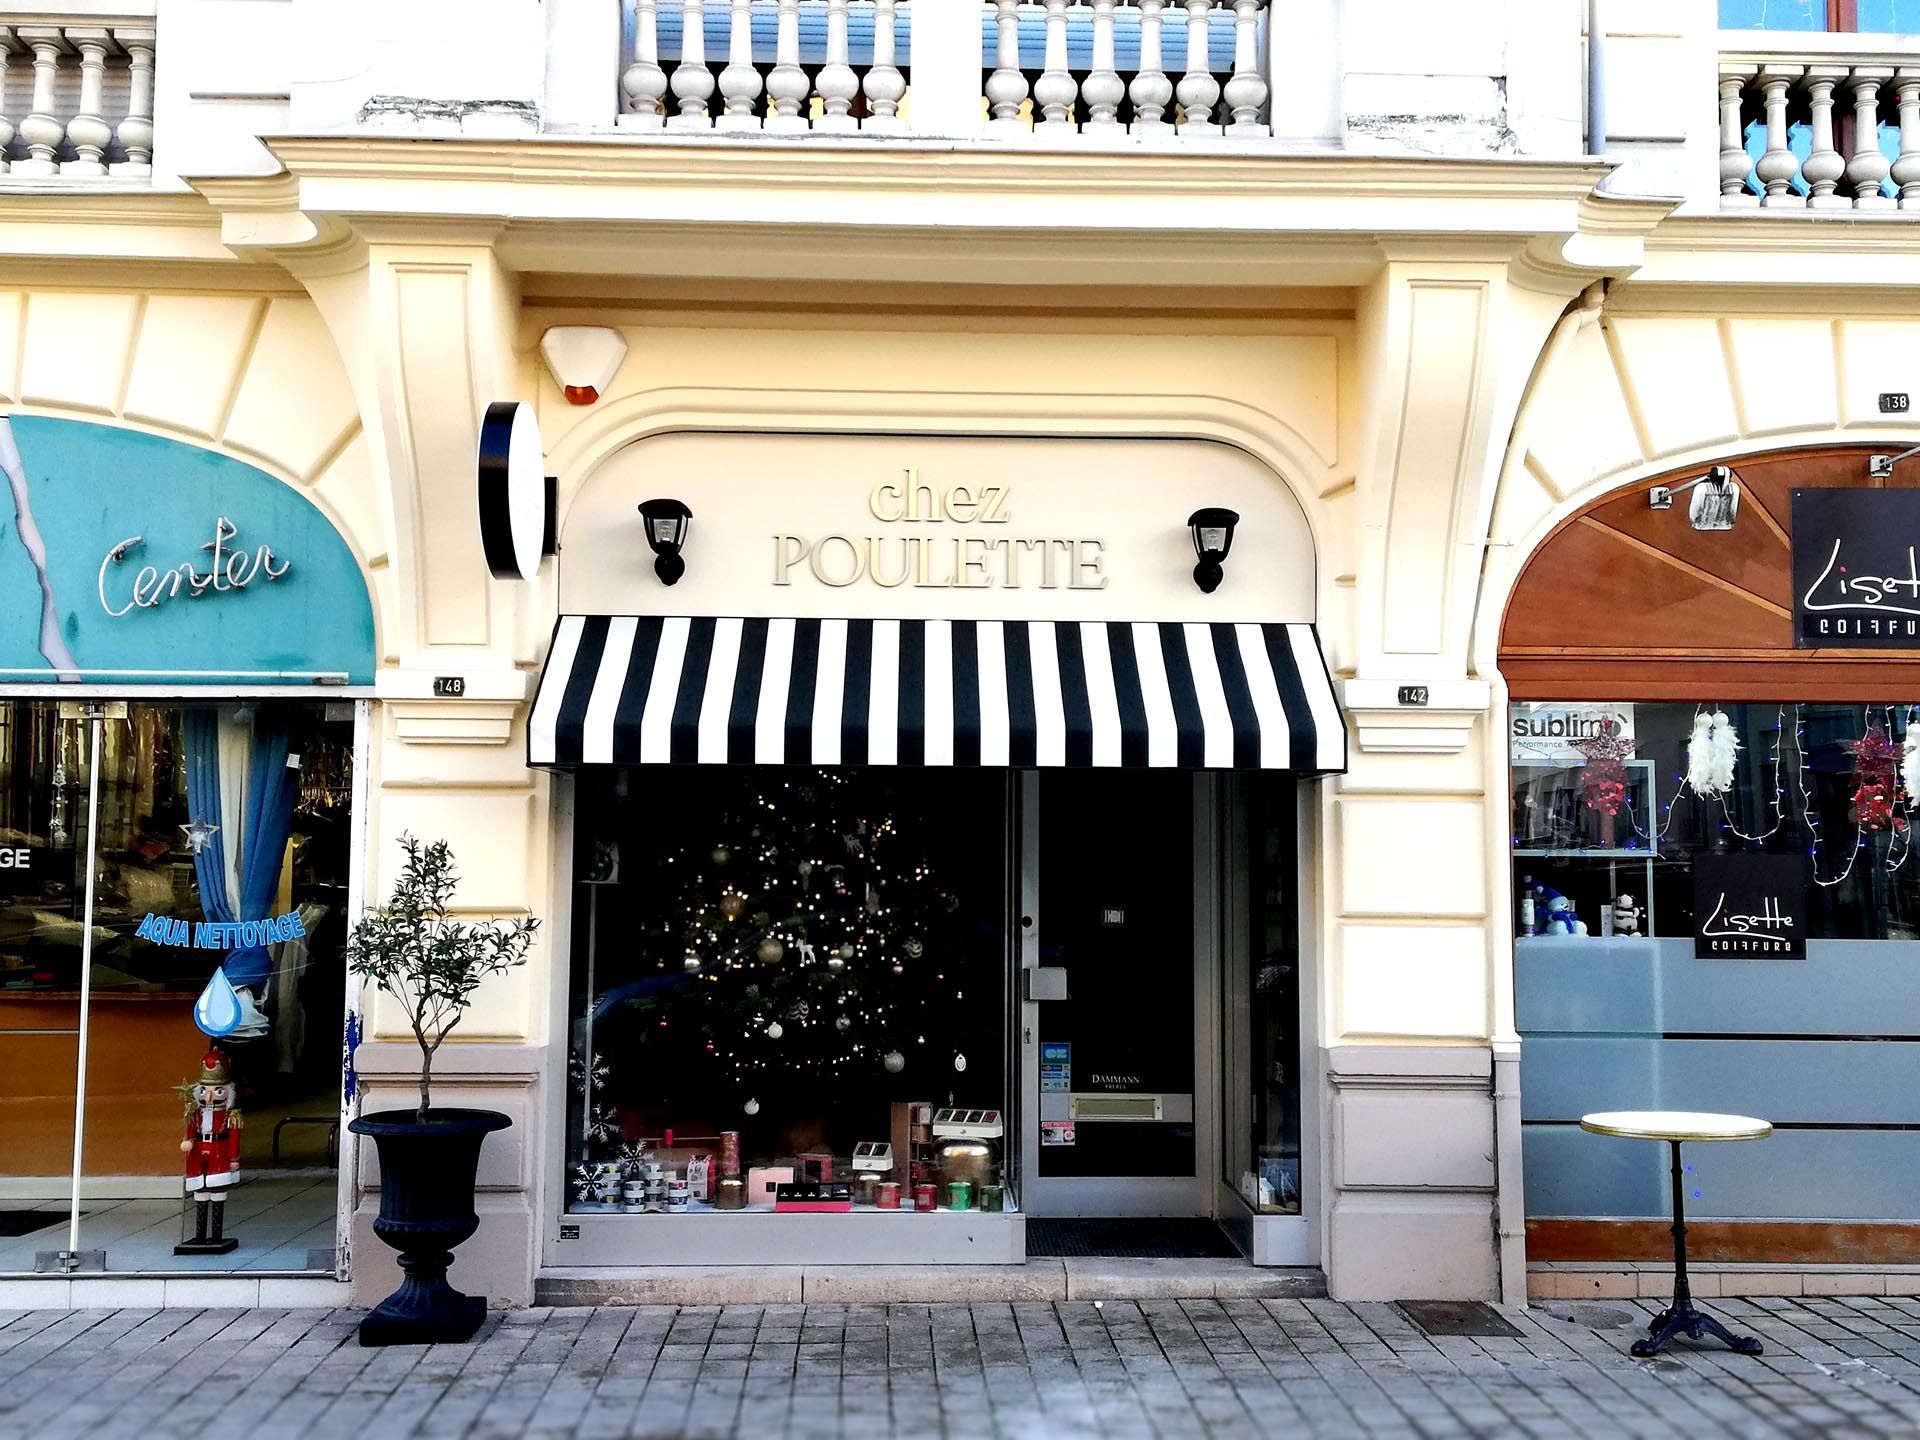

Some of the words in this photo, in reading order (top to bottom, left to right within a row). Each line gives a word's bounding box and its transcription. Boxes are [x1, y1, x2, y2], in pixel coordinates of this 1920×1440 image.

[1886, 396, 1907, 409] 138
[869, 467, 1010, 523] chez
[98, 516, 292, 617] Center
[772, 534, 1109, 589] POULETTE
[438, 679, 461, 692] 148
[1403, 689, 1426, 702] 142
[0, 847, 31, 869] GE
[1702, 892, 1794, 941] Lisette
[135, 912, 189, 947] AQUA
[194, 911, 306, 949] NETTOYAGE
[1711, 941, 1791, 952] COIFFURE
[1091, 1074, 1140, 1084] DAMMANN
